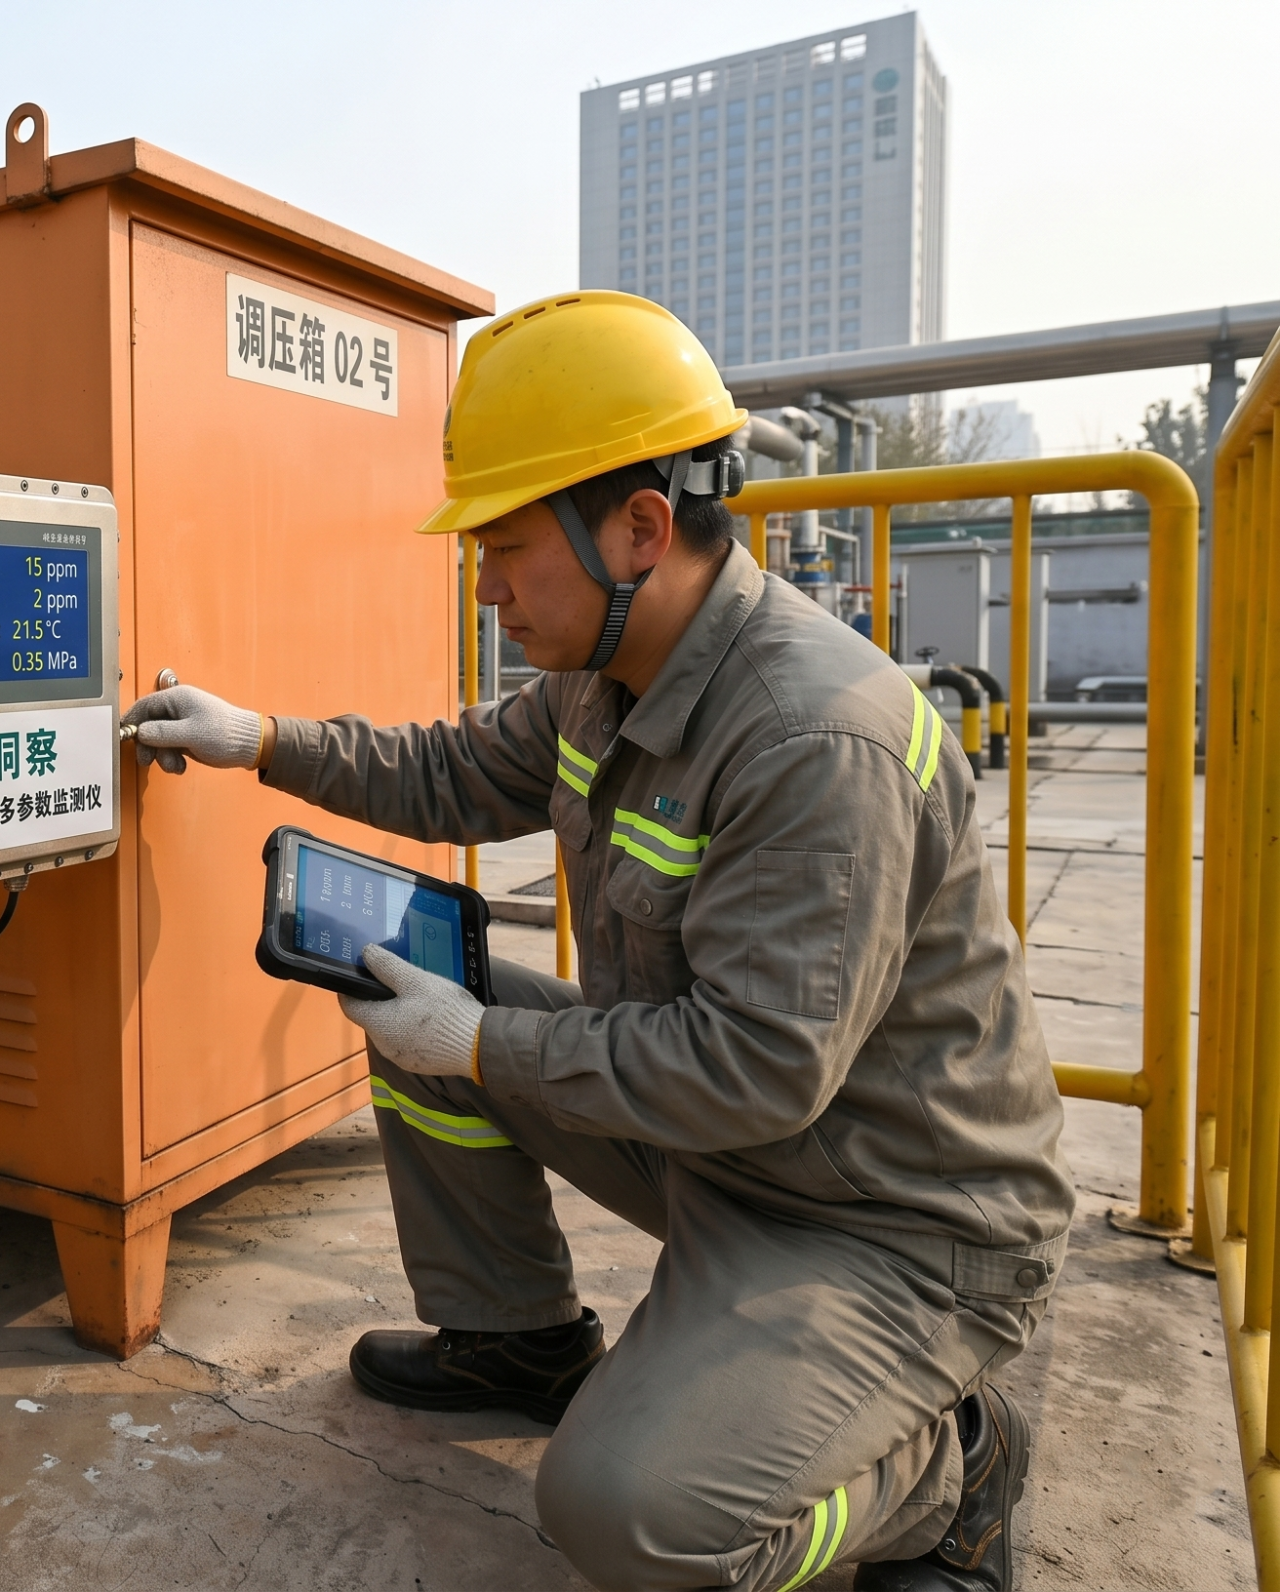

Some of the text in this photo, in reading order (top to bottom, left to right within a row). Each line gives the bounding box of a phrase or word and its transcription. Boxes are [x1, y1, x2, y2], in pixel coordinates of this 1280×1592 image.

[235, 294, 393, 401] 调压箱 02 号
[25, 556, 42, 577] 15
[47, 563, 77, 582] ppm
[33, 588, 42, 608] 2
[47, 593, 78, 613] ppm
[12, 619, 44, 640] 21.5
[46, 620, 61, 639] °C
[12, 652, 44, 672] 0.35
[48, 651, 77, 670] MPa
